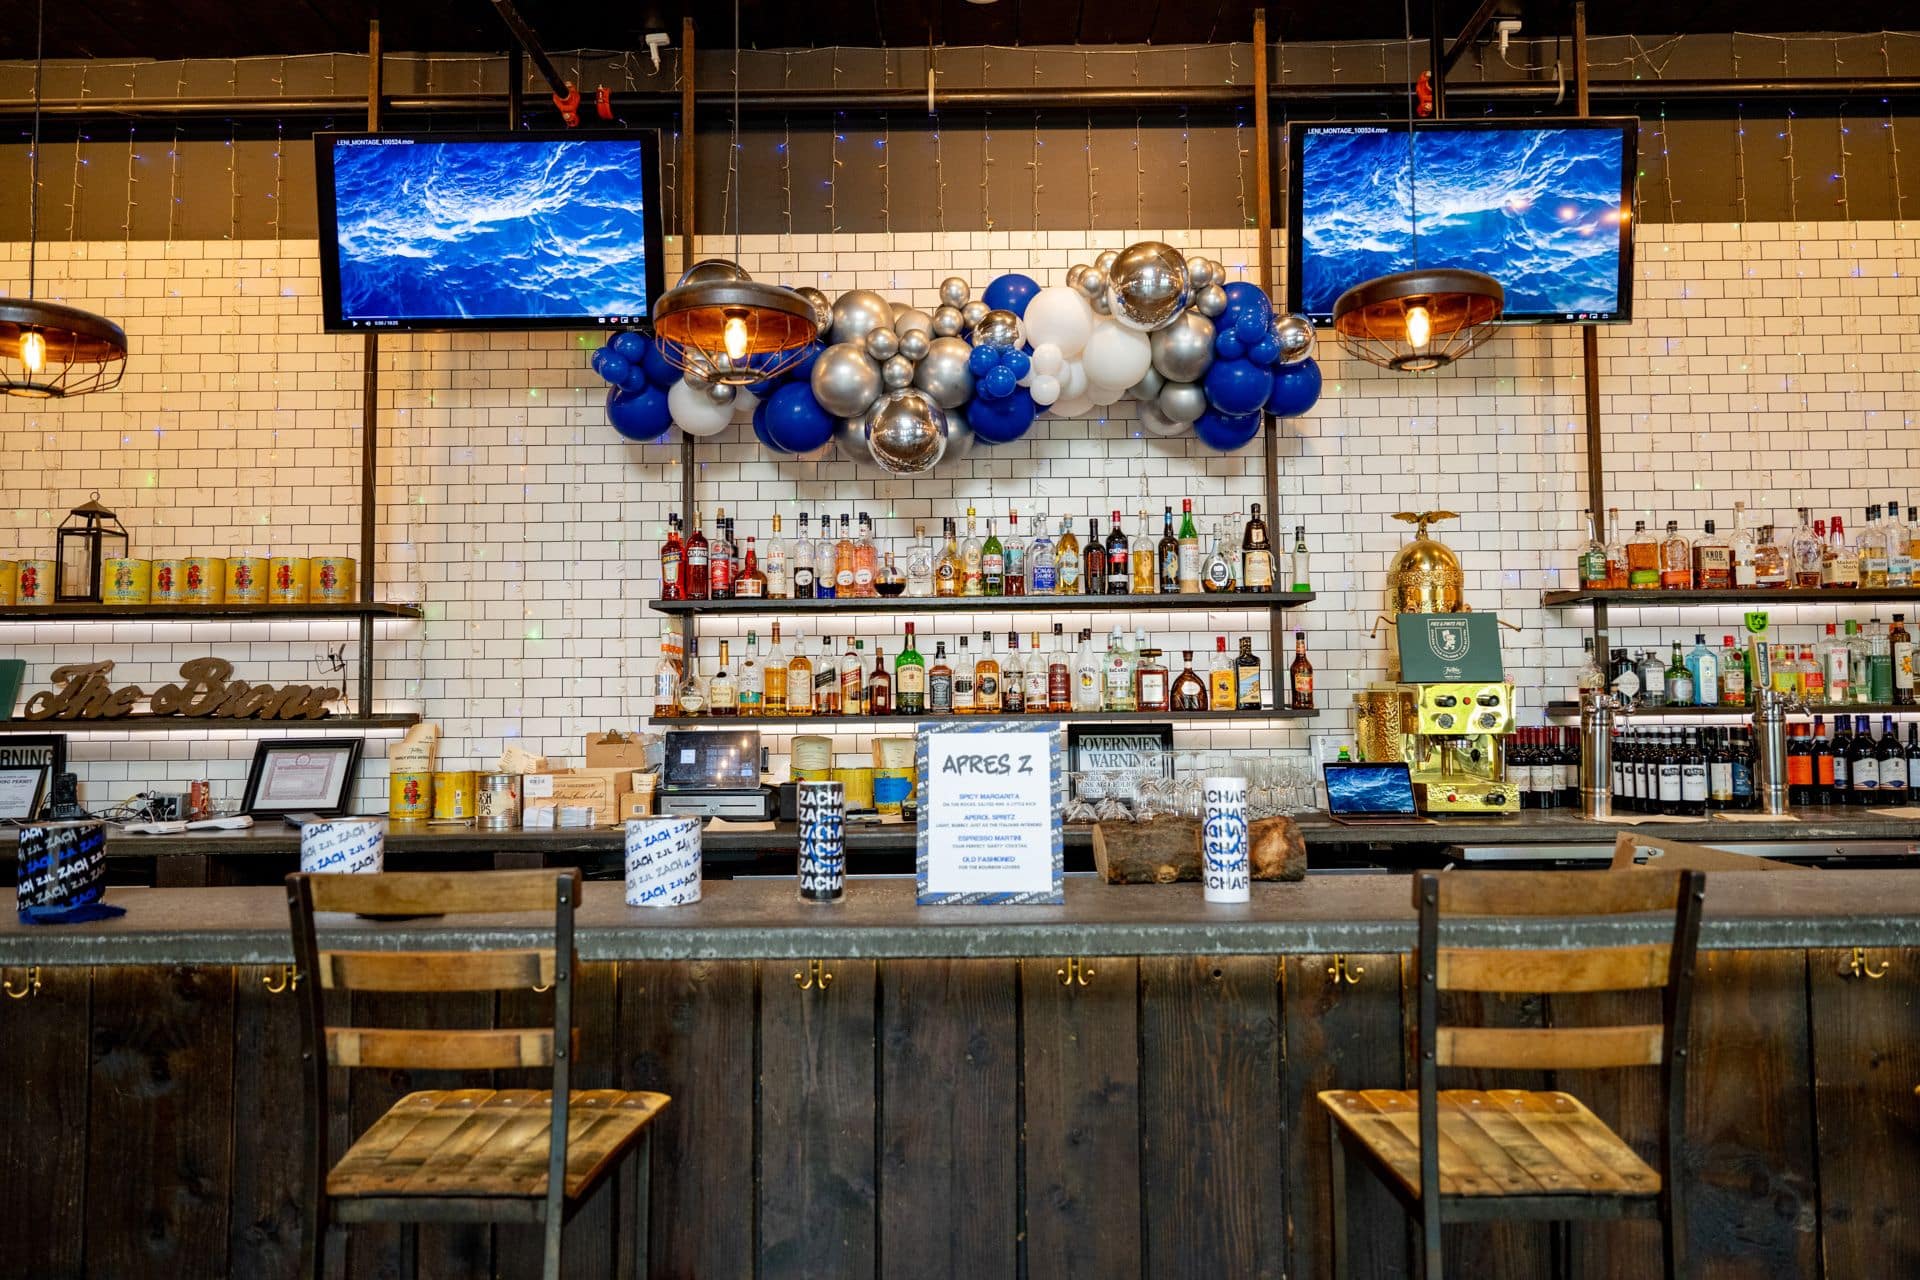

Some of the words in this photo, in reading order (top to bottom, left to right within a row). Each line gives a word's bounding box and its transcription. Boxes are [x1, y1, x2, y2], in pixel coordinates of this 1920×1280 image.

[942, 753, 1011, 776] APRES
[643, 828, 671, 848] ZACH
[317, 850, 346, 870] ZACH
[19, 879, 34, 896] ACH
[57, 857, 89, 880] ZACH
[640, 884, 667, 904] ZACH
